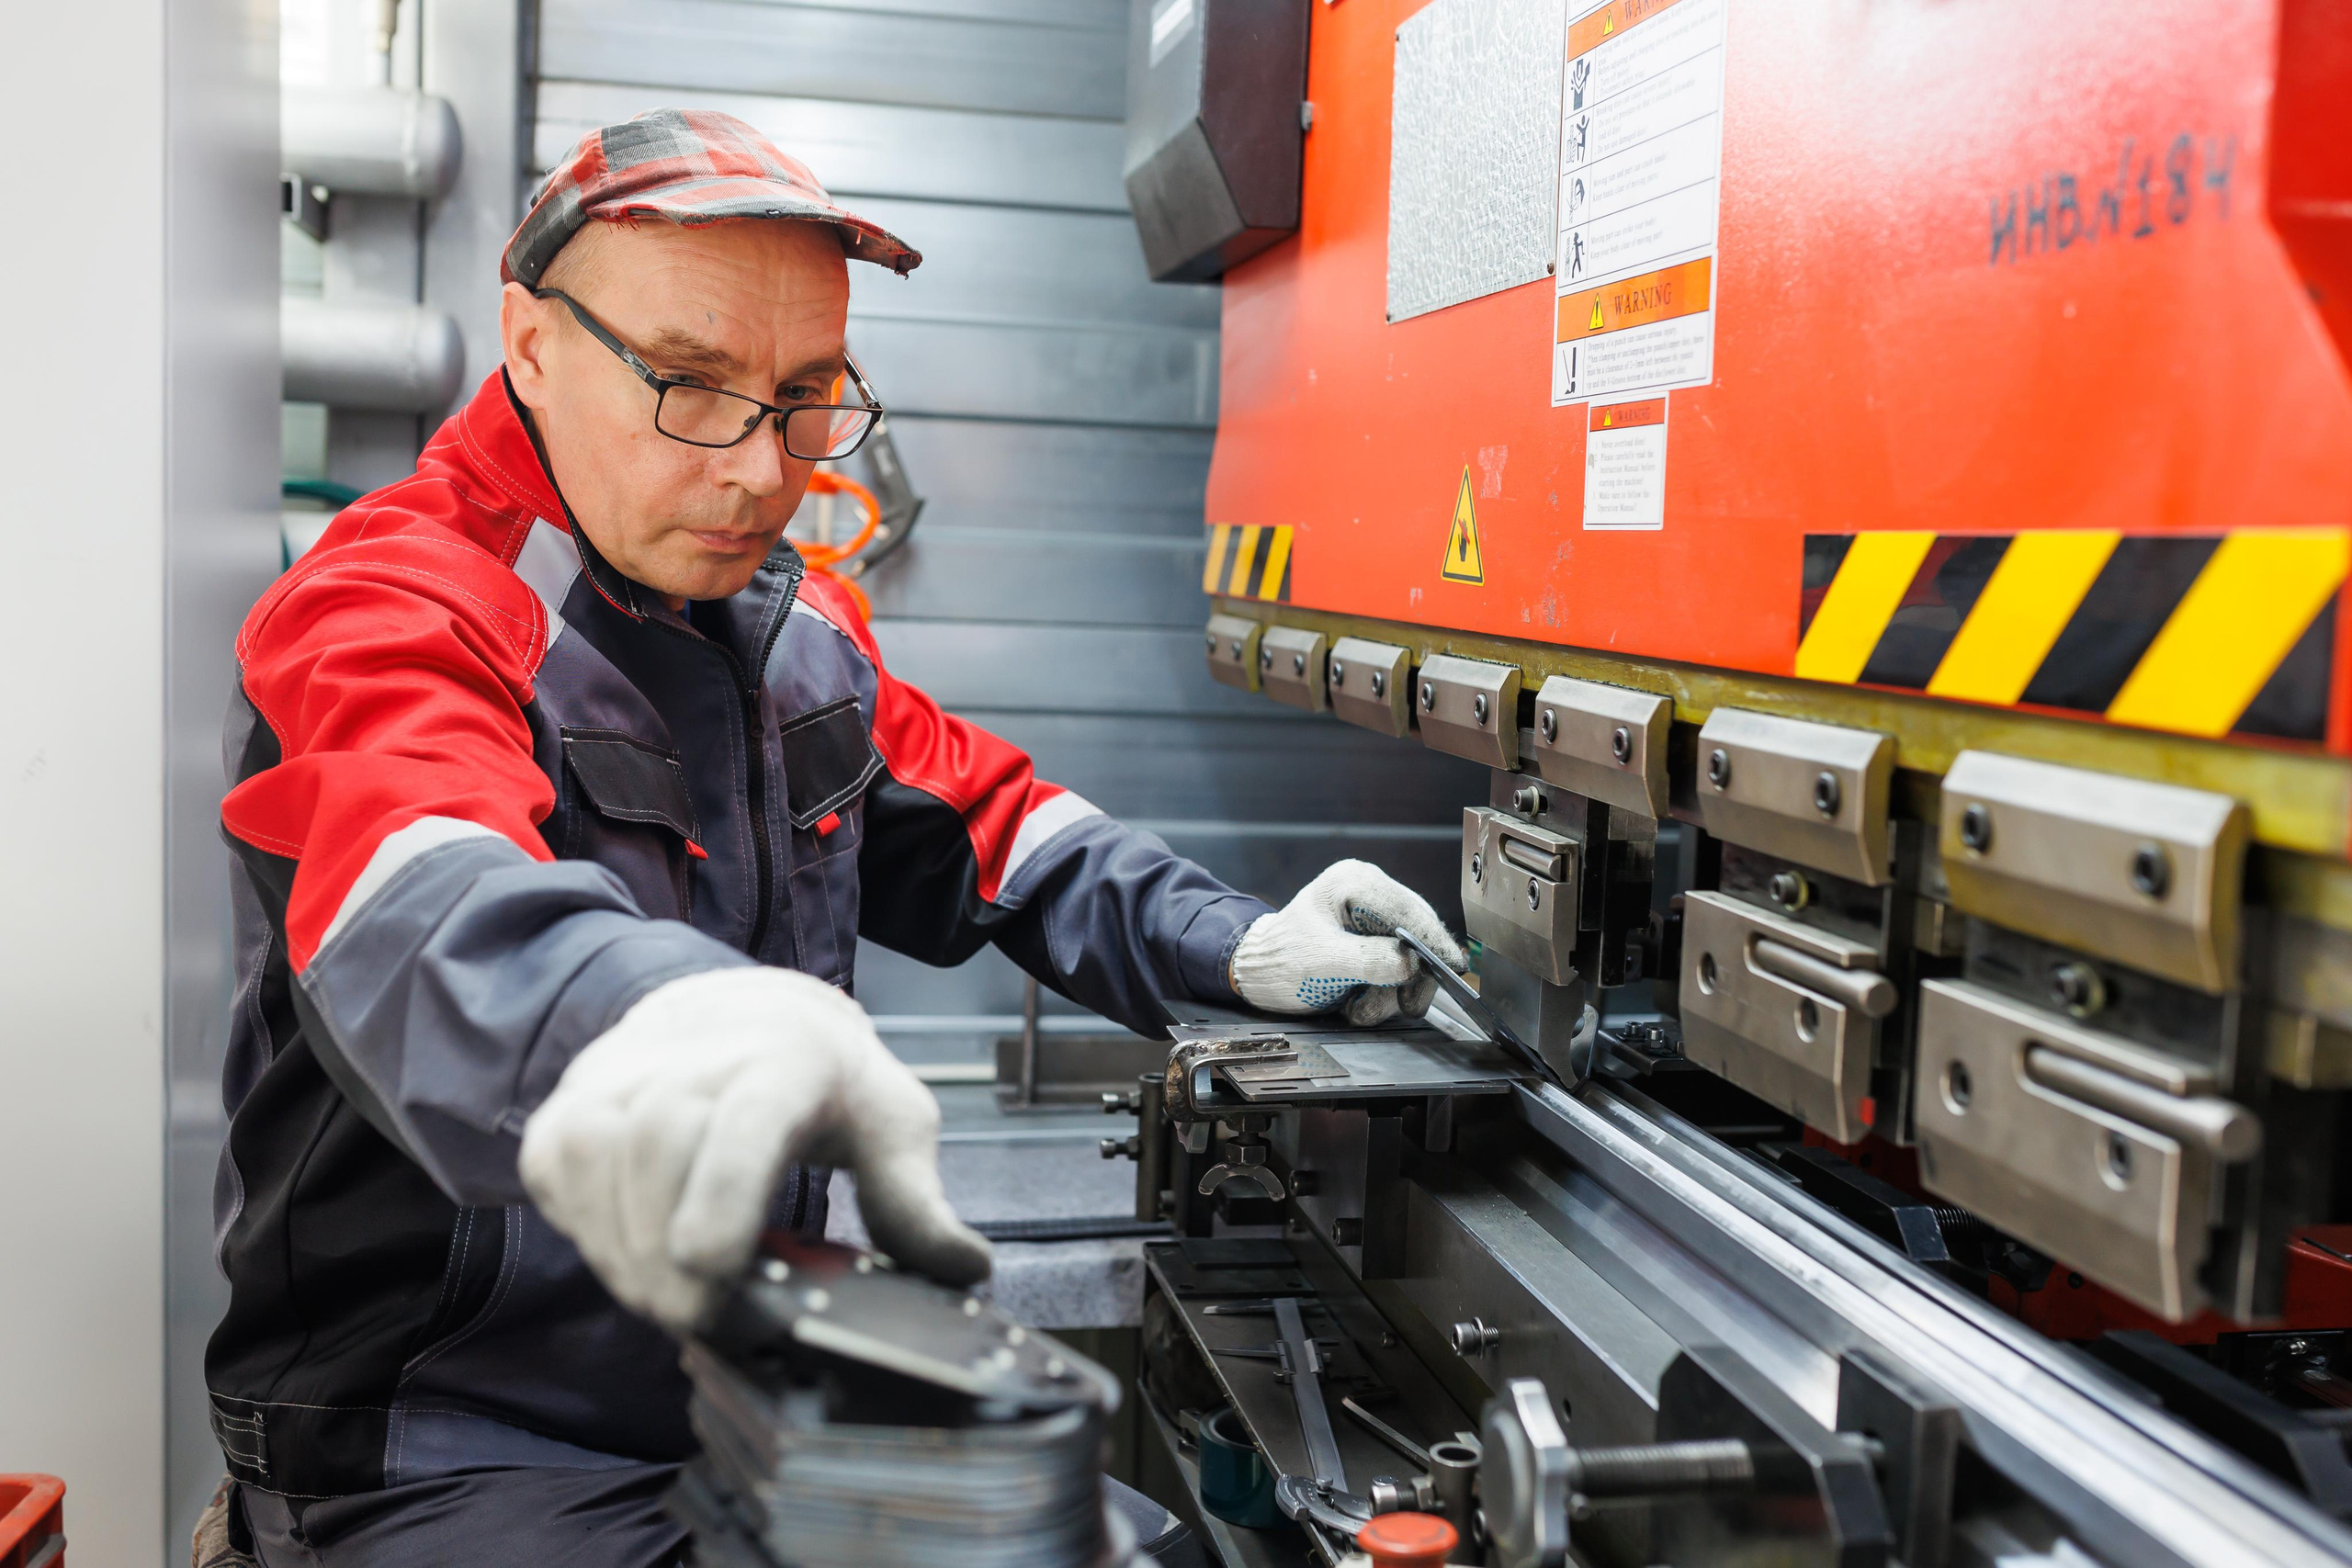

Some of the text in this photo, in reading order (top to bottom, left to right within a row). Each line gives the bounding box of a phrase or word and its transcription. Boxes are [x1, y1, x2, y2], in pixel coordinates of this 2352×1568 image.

[1592, 194, 1601, 202] Keep
[1590, 252, 1599, 260] Keep
[1614, 282, 1672, 316] WARNING
[1618, 407, 1650, 422] WARNING
[1600, 452, 1613, 460] Please
